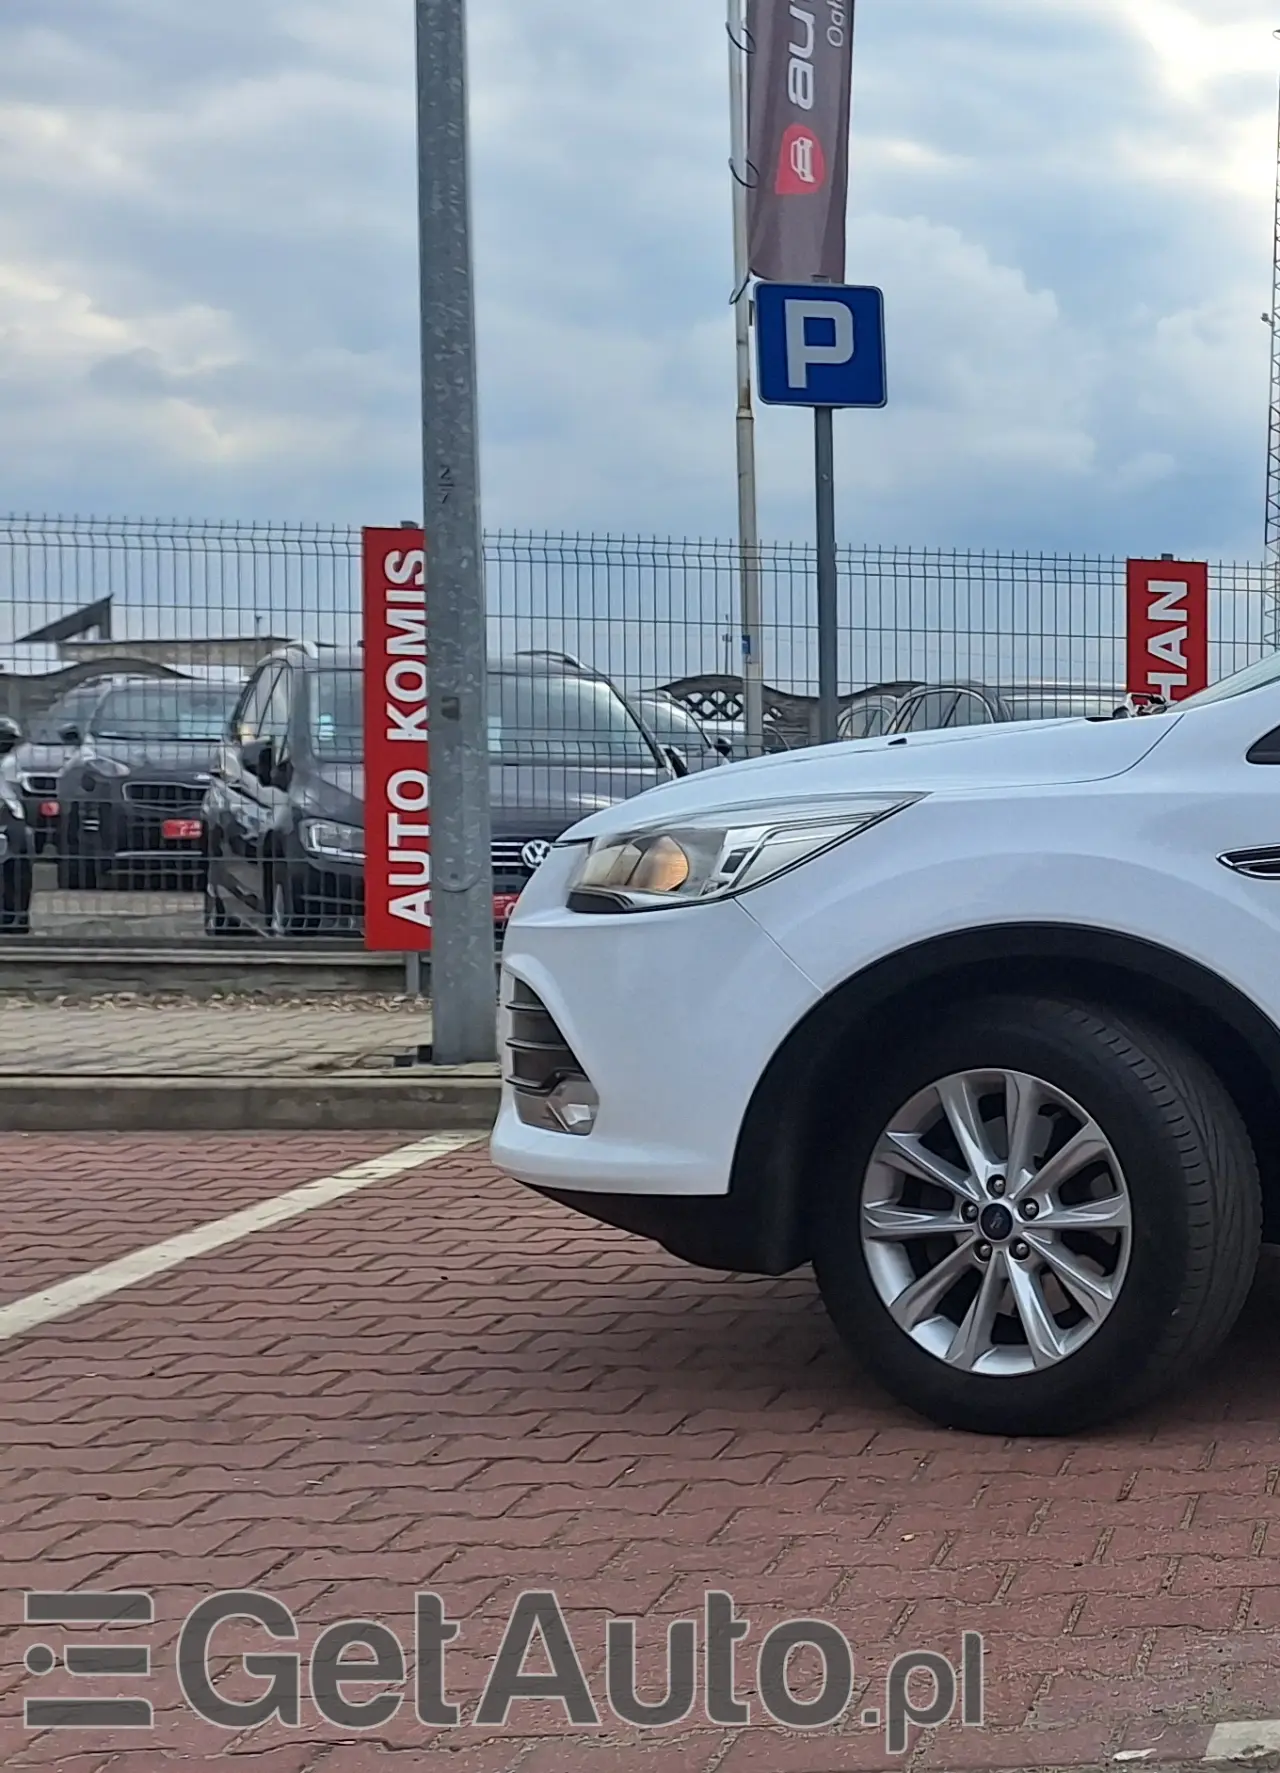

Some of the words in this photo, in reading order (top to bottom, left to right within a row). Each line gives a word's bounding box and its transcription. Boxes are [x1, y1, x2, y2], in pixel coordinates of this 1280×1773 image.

[788, 0, 815, 110] au
[784, 298, 855, 389] P
[384, 549, 429, 742] KOMIS
[1147, 580, 1188, 702] HAN
[386, 769, 433, 928] AUTO
